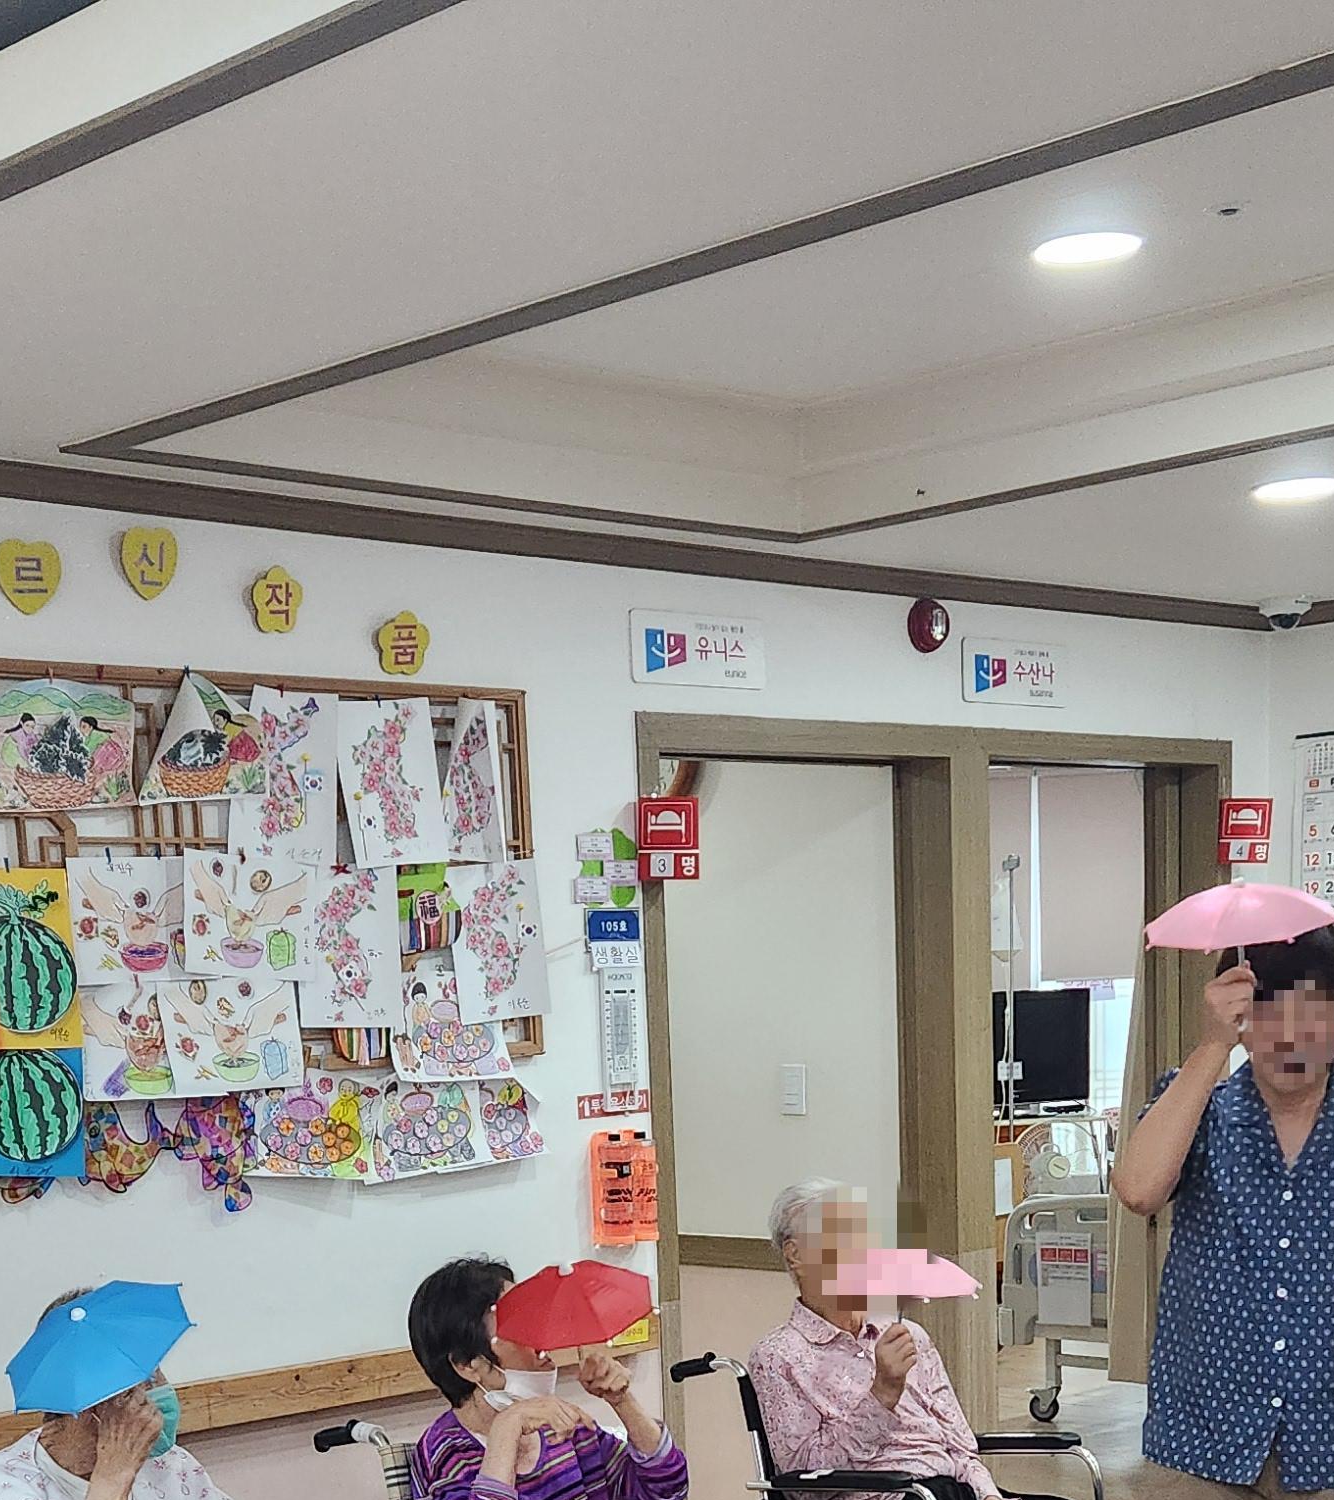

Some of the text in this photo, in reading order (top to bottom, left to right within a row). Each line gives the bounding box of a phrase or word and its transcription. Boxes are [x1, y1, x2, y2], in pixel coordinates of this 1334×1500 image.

[695, 637, 746, 662] 유니스
[1013, 661, 1055, 685] 수산나
[1309, 824, 1317, 836] 5
[1236, 844, 1267, 860] 4 명
[1305, 854, 1320, 866] 12
[657, 858, 667, 873] 3
[682, 855, 696, 875] 명
[1305, 882, 1319, 895] 19
[419, 894, 439, 920] 福
[600, 921, 627, 932] 105호
[595, 946, 640, 965] 생활실
